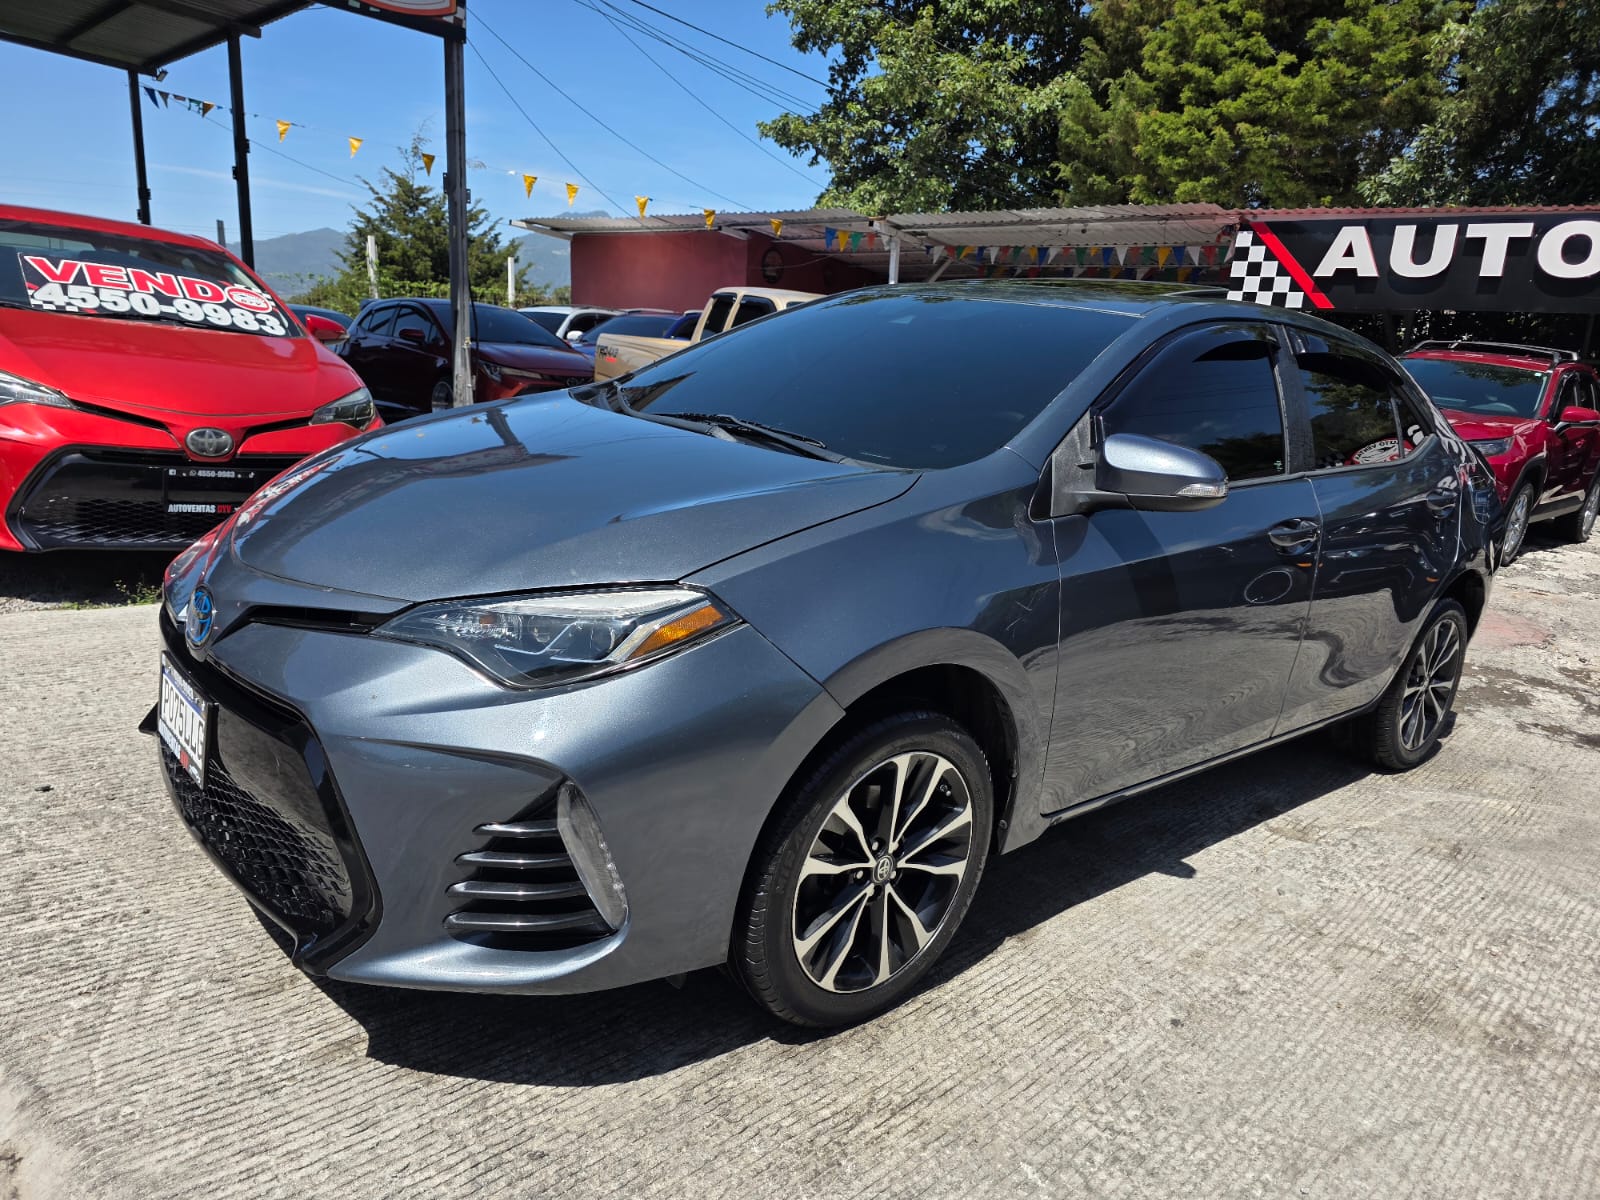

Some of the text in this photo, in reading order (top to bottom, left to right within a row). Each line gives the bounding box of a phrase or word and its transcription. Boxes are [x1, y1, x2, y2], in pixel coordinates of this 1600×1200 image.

[1313, 220, 1600, 278] AUTO
[33, 283, 287, 336] 4550-9983
[168, 504, 216, 513] AUTOVENTAS
